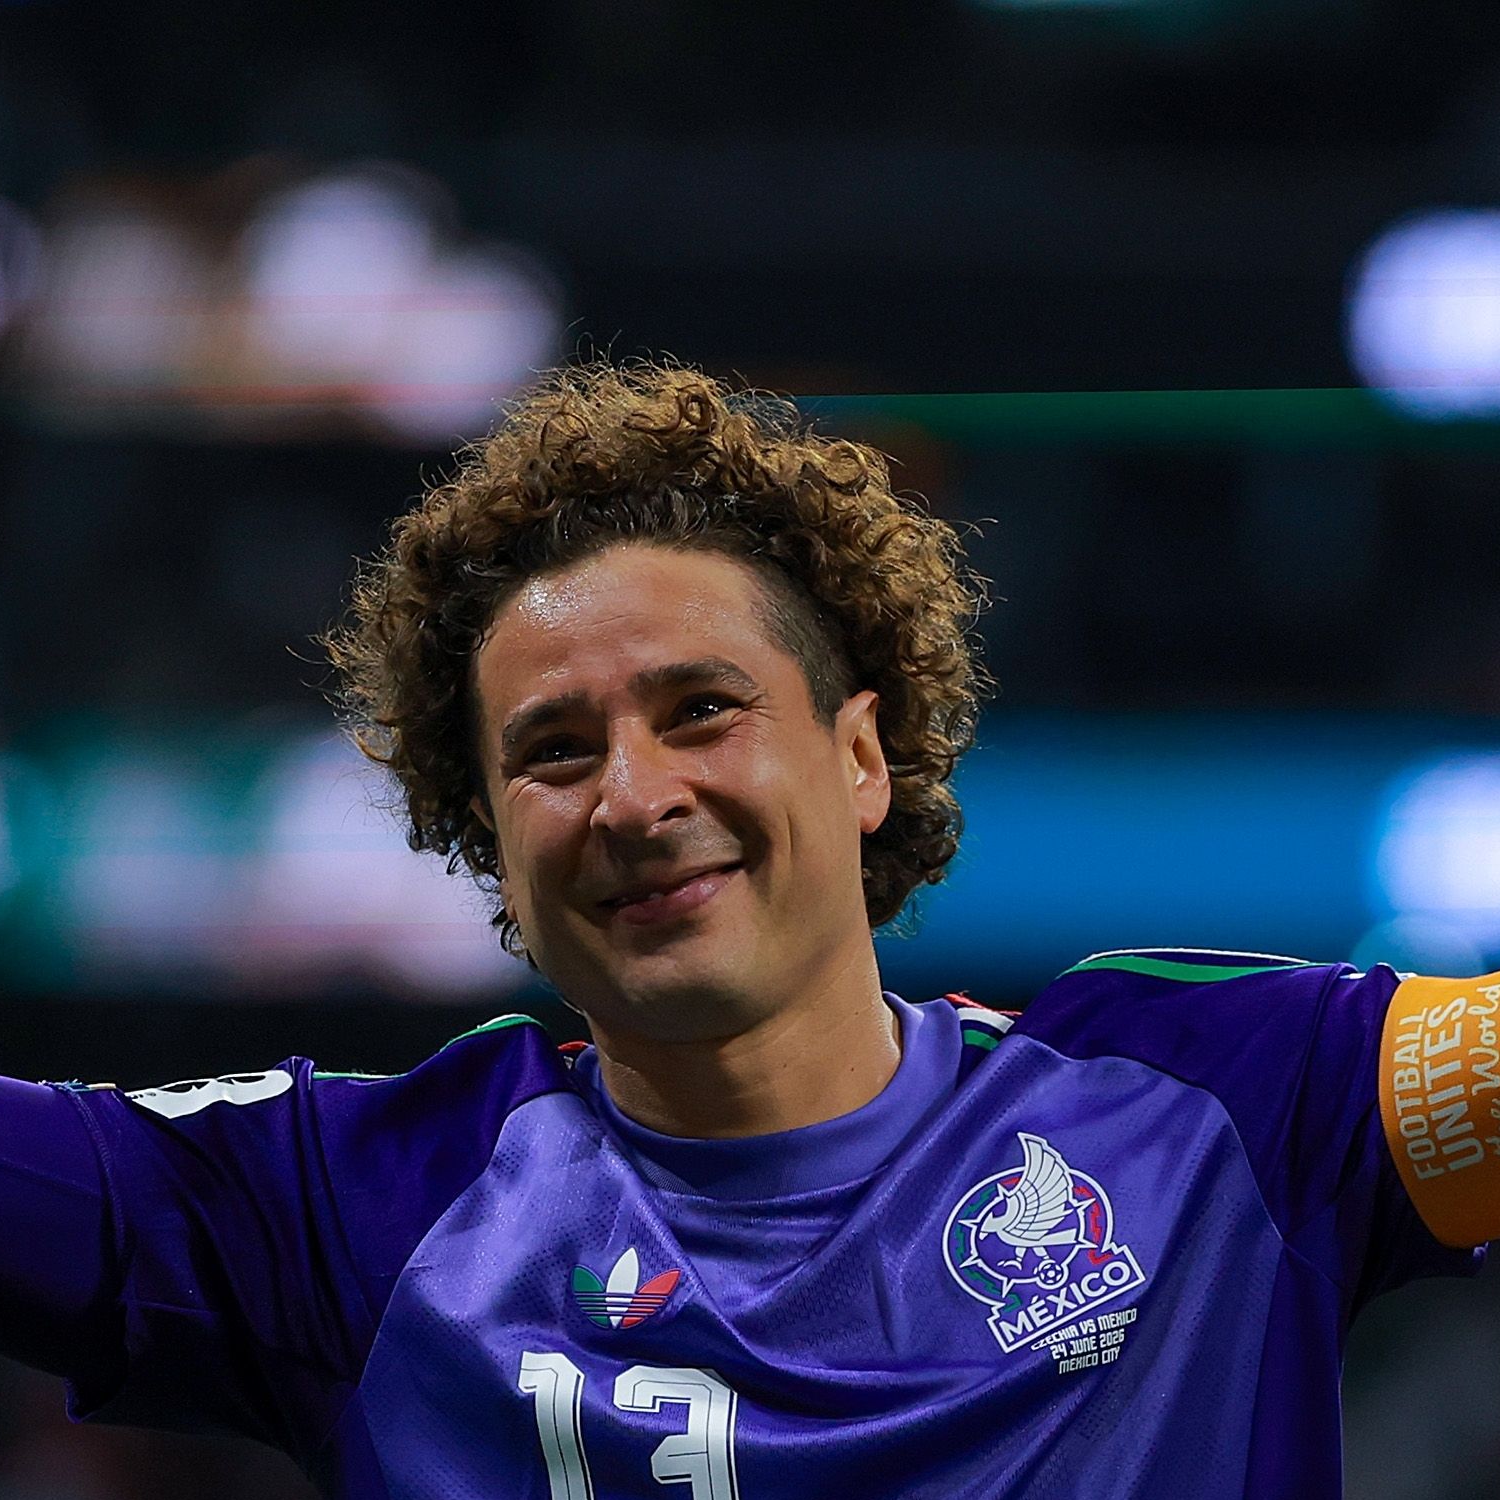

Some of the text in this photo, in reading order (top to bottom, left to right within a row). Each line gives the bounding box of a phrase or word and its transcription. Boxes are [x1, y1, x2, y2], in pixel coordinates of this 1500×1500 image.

[1393, 1006, 1445, 1180] FOOTBALL
[1424, 996, 1485, 1172] UNITES
[999, 1260, 1131, 1343] MÉXICO
[1030, 1308, 1137, 1351] CZECHIA VS MEXICO
[1050, 1328, 1125, 1360] 24 JUNE 2026
[1059, 1346, 1120, 1375] MEXICO CITY
